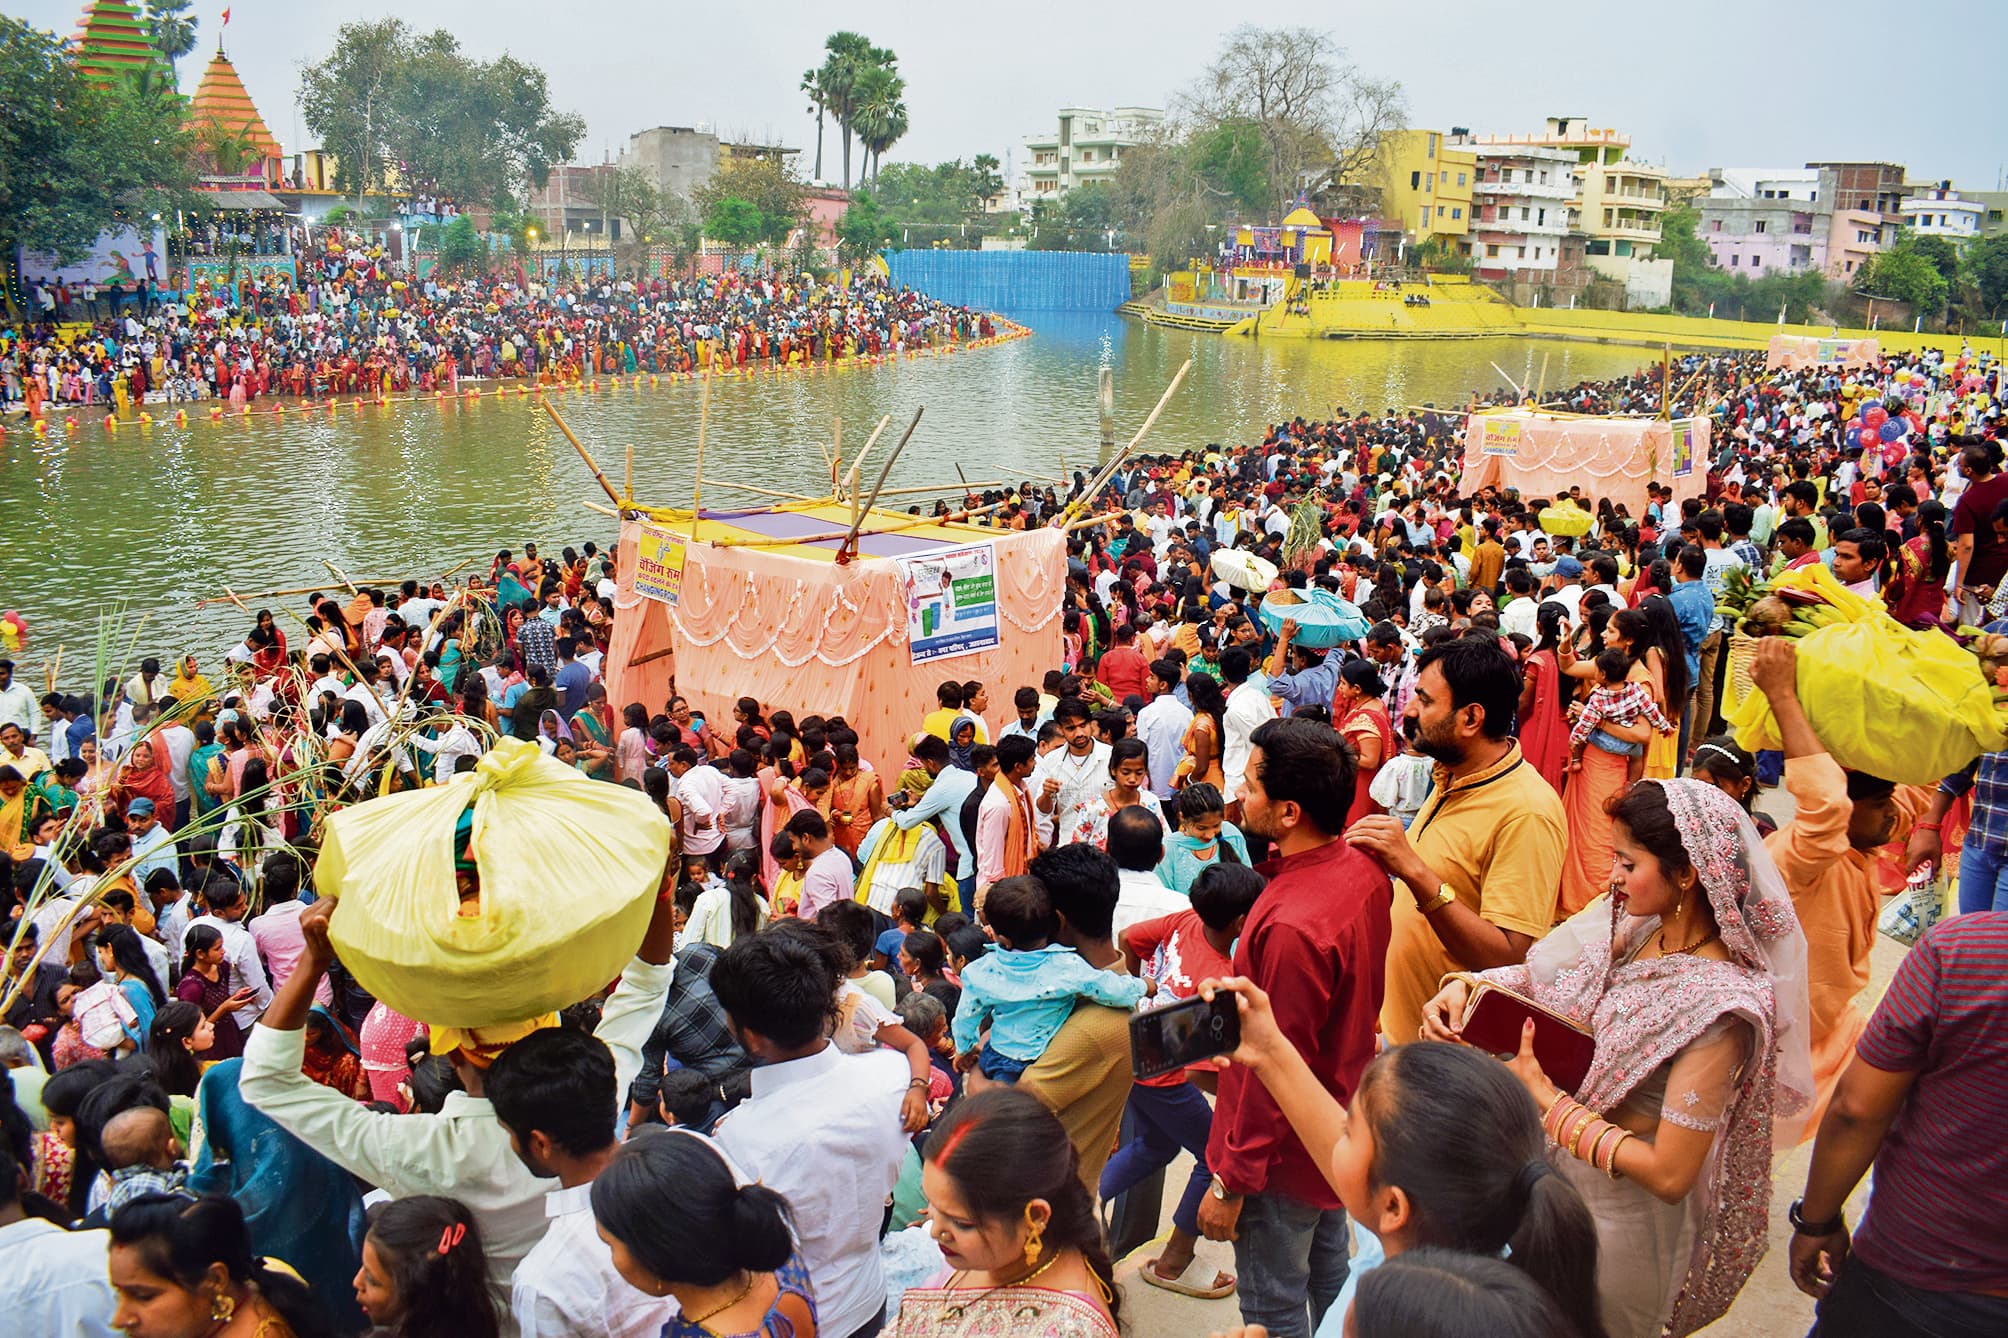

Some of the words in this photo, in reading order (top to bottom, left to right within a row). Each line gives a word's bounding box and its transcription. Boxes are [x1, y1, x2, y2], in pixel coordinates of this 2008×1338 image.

[667, 568, 680, 580] रूम
[635, 581, 663, 597] CHANGING
[664, 590, 677, 602] ROOM
